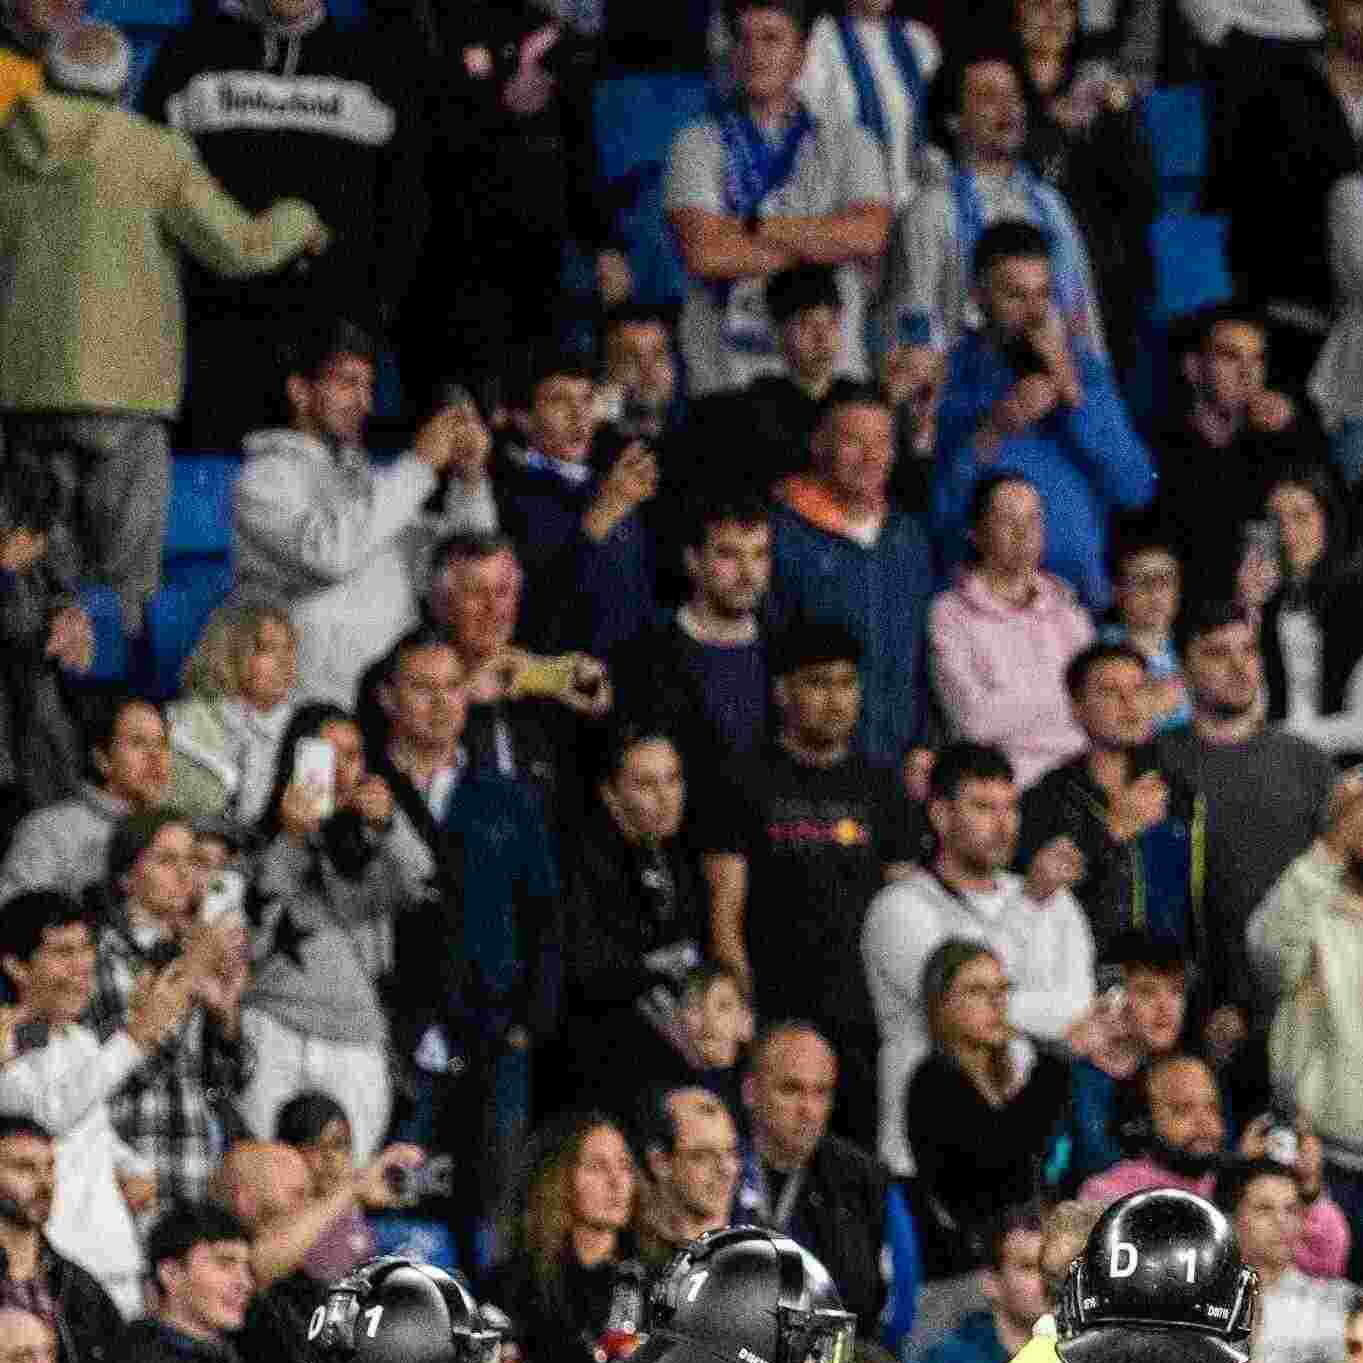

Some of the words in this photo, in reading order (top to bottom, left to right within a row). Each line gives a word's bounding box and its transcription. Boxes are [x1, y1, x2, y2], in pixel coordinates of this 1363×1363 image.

[1109, 1242, 1139, 1279] D
[1177, 1247, 1198, 1284] 1
[687, 1270, 710, 1302] 1
[364, 1304, 385, 1339] 1
